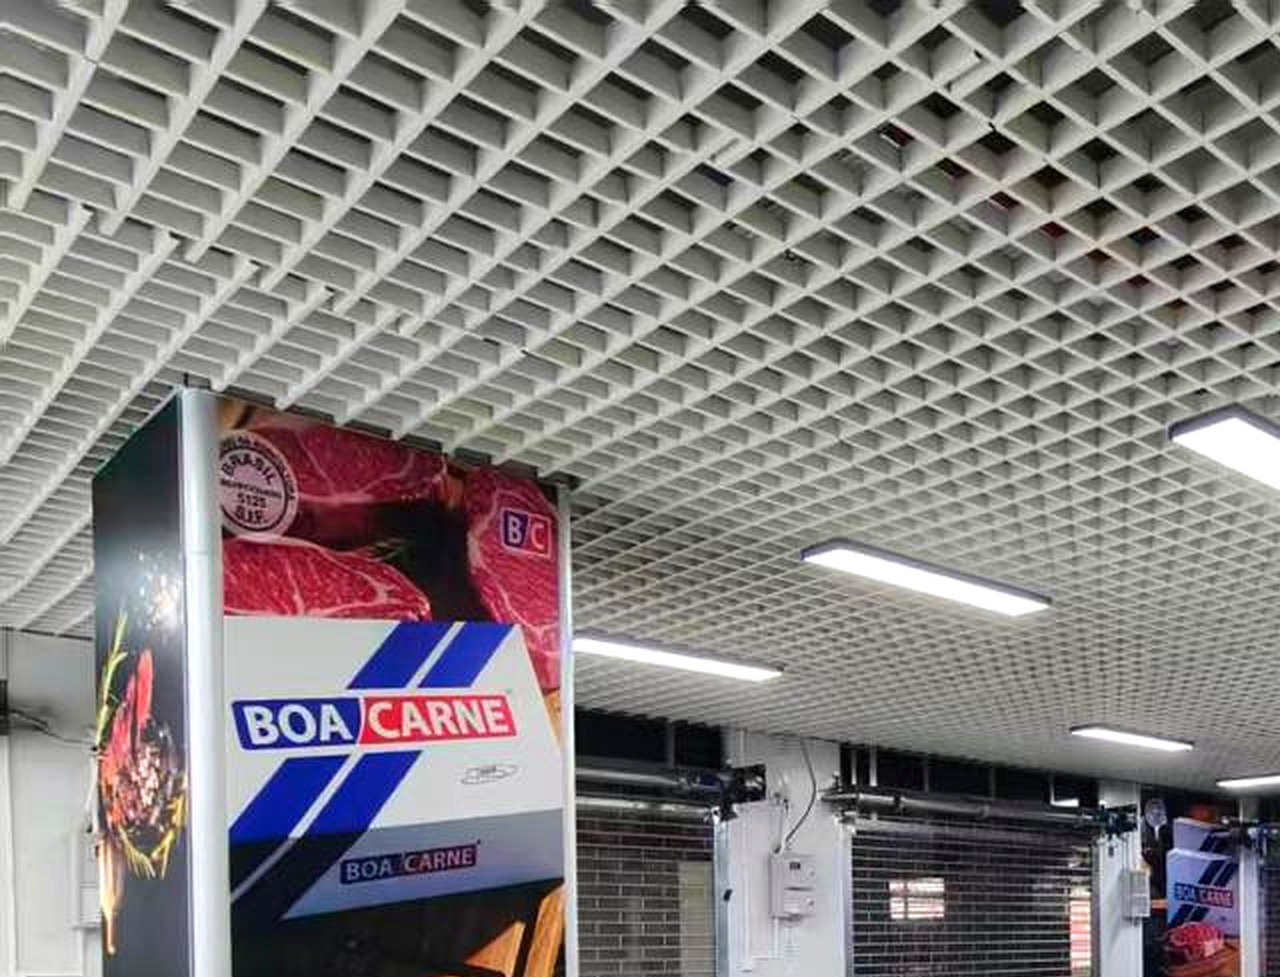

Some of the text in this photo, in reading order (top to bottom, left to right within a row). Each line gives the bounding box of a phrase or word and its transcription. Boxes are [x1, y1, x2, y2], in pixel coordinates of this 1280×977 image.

[220, 453, 276, 486] BRASIL
[243, 699, 512, 746] BOA CARNE
[346, 847, 473, 882] BOA CARNE
